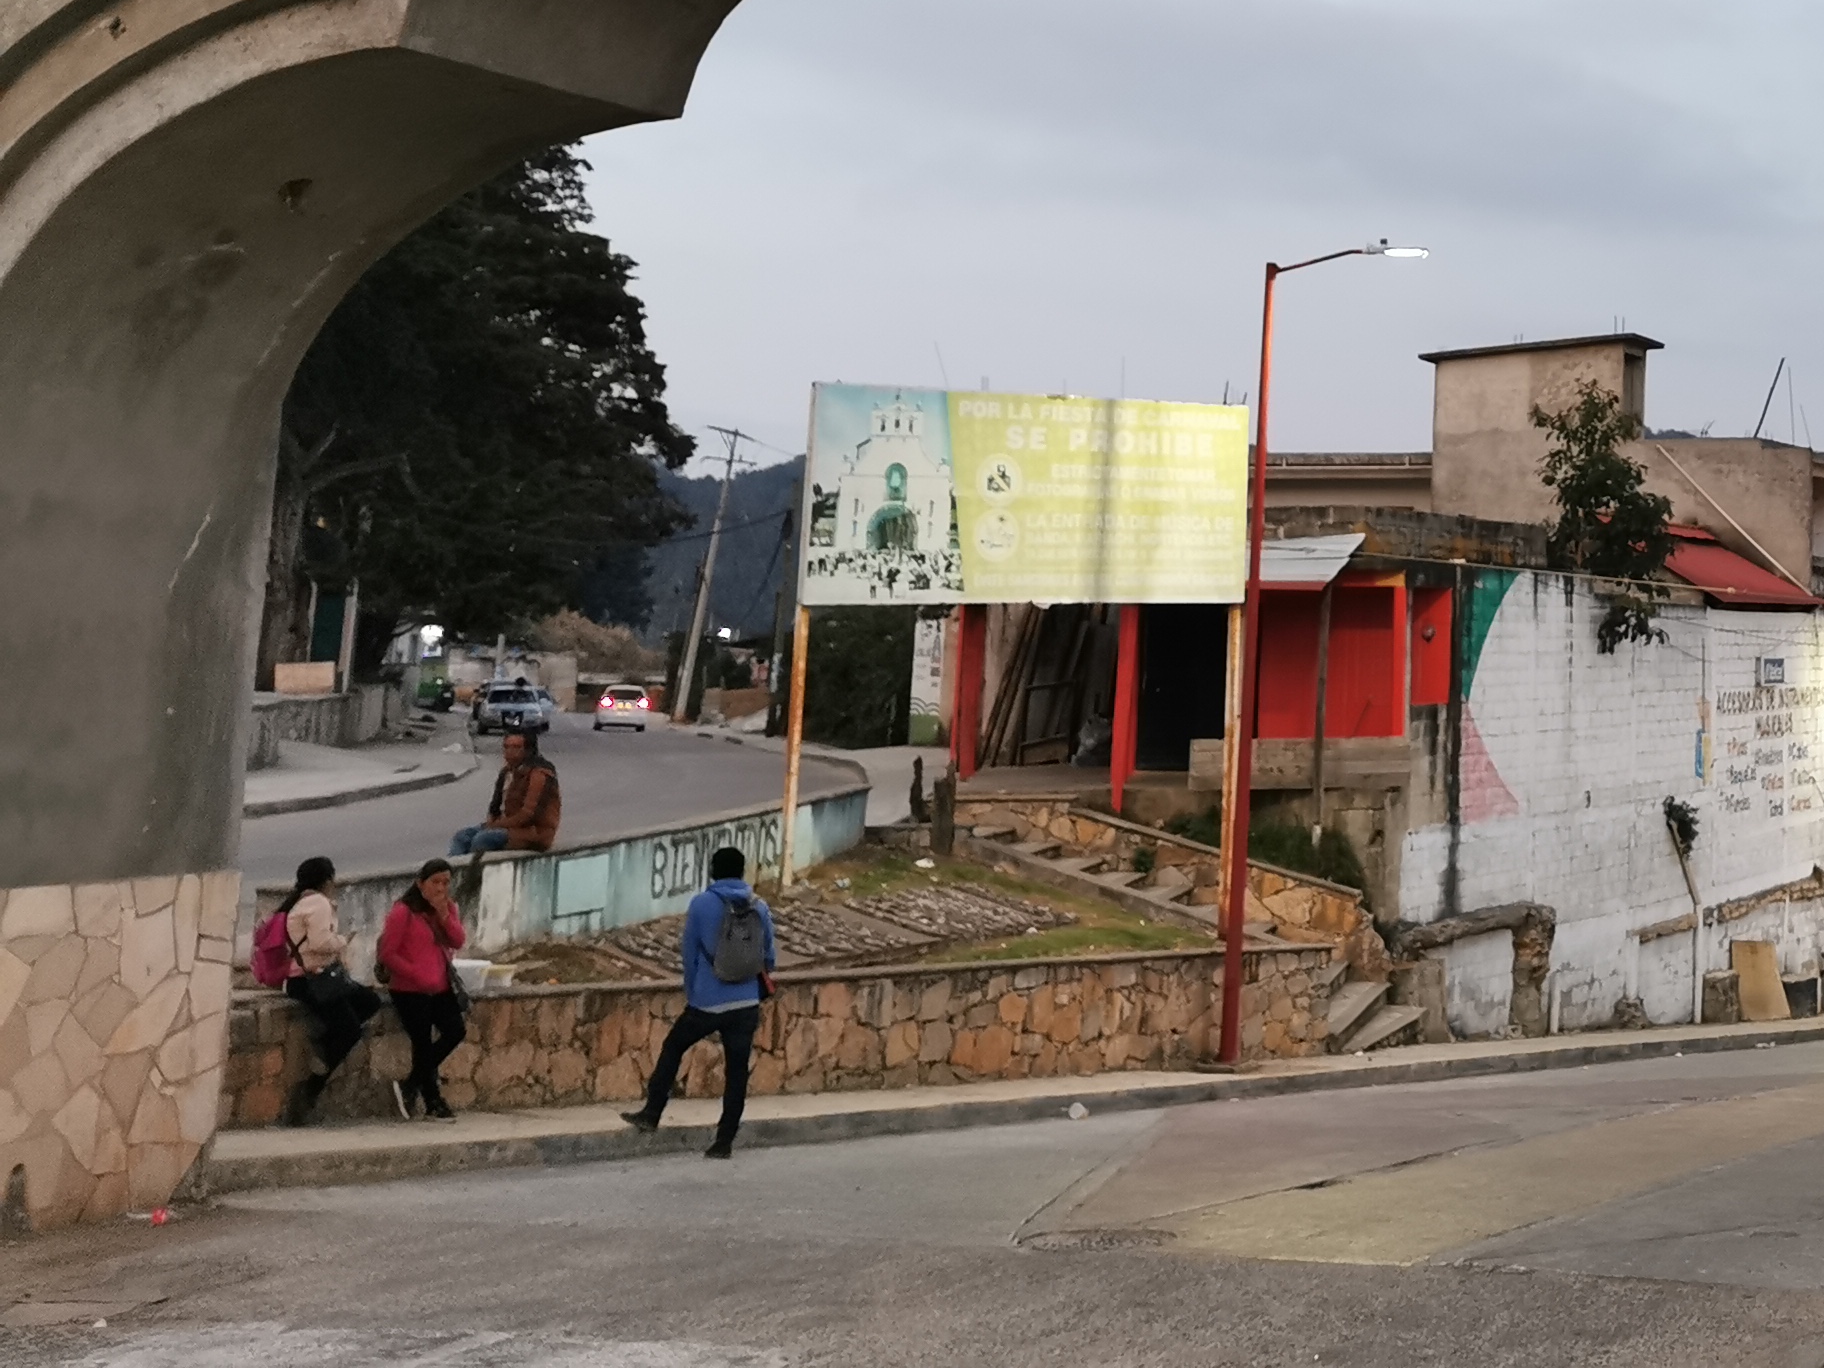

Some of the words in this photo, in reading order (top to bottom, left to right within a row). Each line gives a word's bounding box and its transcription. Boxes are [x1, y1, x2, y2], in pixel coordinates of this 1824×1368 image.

[958, 401, 1001, 419] POR
[1008, 403, 1034, 421] LA
[1039, 404, 1108, 424] FIESTA
[1114, 408, 1138, 426] DE
[1005, 426, 1047, 450] SE
[1069, 428, 1214, 458] PROHIBE
[1025, 513, 1047, 528] LA
